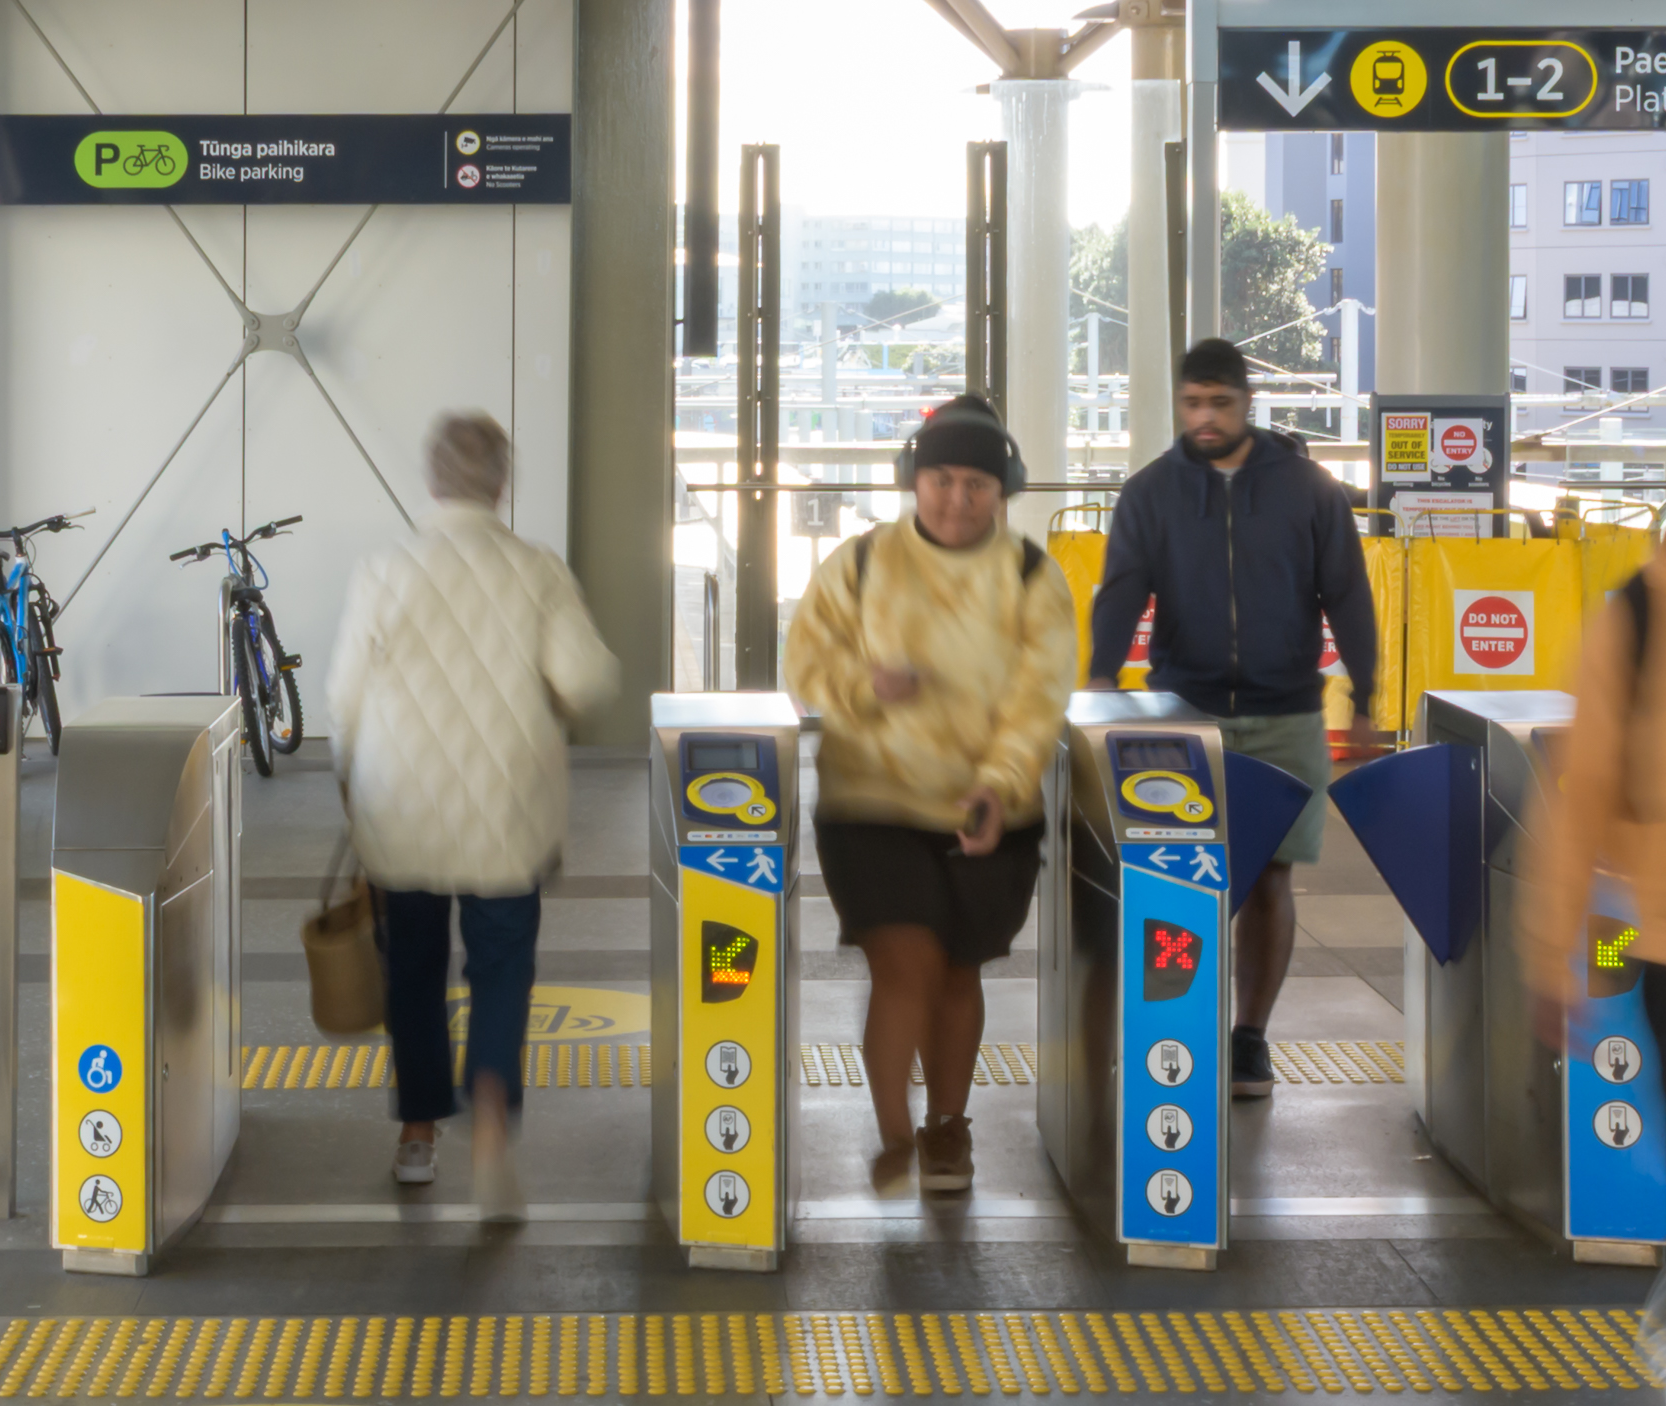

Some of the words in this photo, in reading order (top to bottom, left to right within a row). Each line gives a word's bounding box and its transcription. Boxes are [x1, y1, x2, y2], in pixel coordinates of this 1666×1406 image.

[199, 141, 252, 159] Tūnga
[257, 140, 335, 159] paihikara
[95, 143, 120, 176] P
[200, 164, 235, 179] Bike
[240, 163, 304, 182] parking
[1388, 418, 1425, 429] SORRY
[1391, 441, 1408, 450] OUT
[1411, 441, 1423, 450] OF
[1388, 451, 1425, 459] SERVICE
[1387, 463, 1397, 471] DO
[1398, 463, 1411, 471] NOT
[1412, 463, 1425, 471] USE
[807, 498, 824, 526] 1
[1468, 613, 1486, 625] DO
[1490, 613, 1518, 625] NOT
[1471, 639, 1515, 652] ENTER
